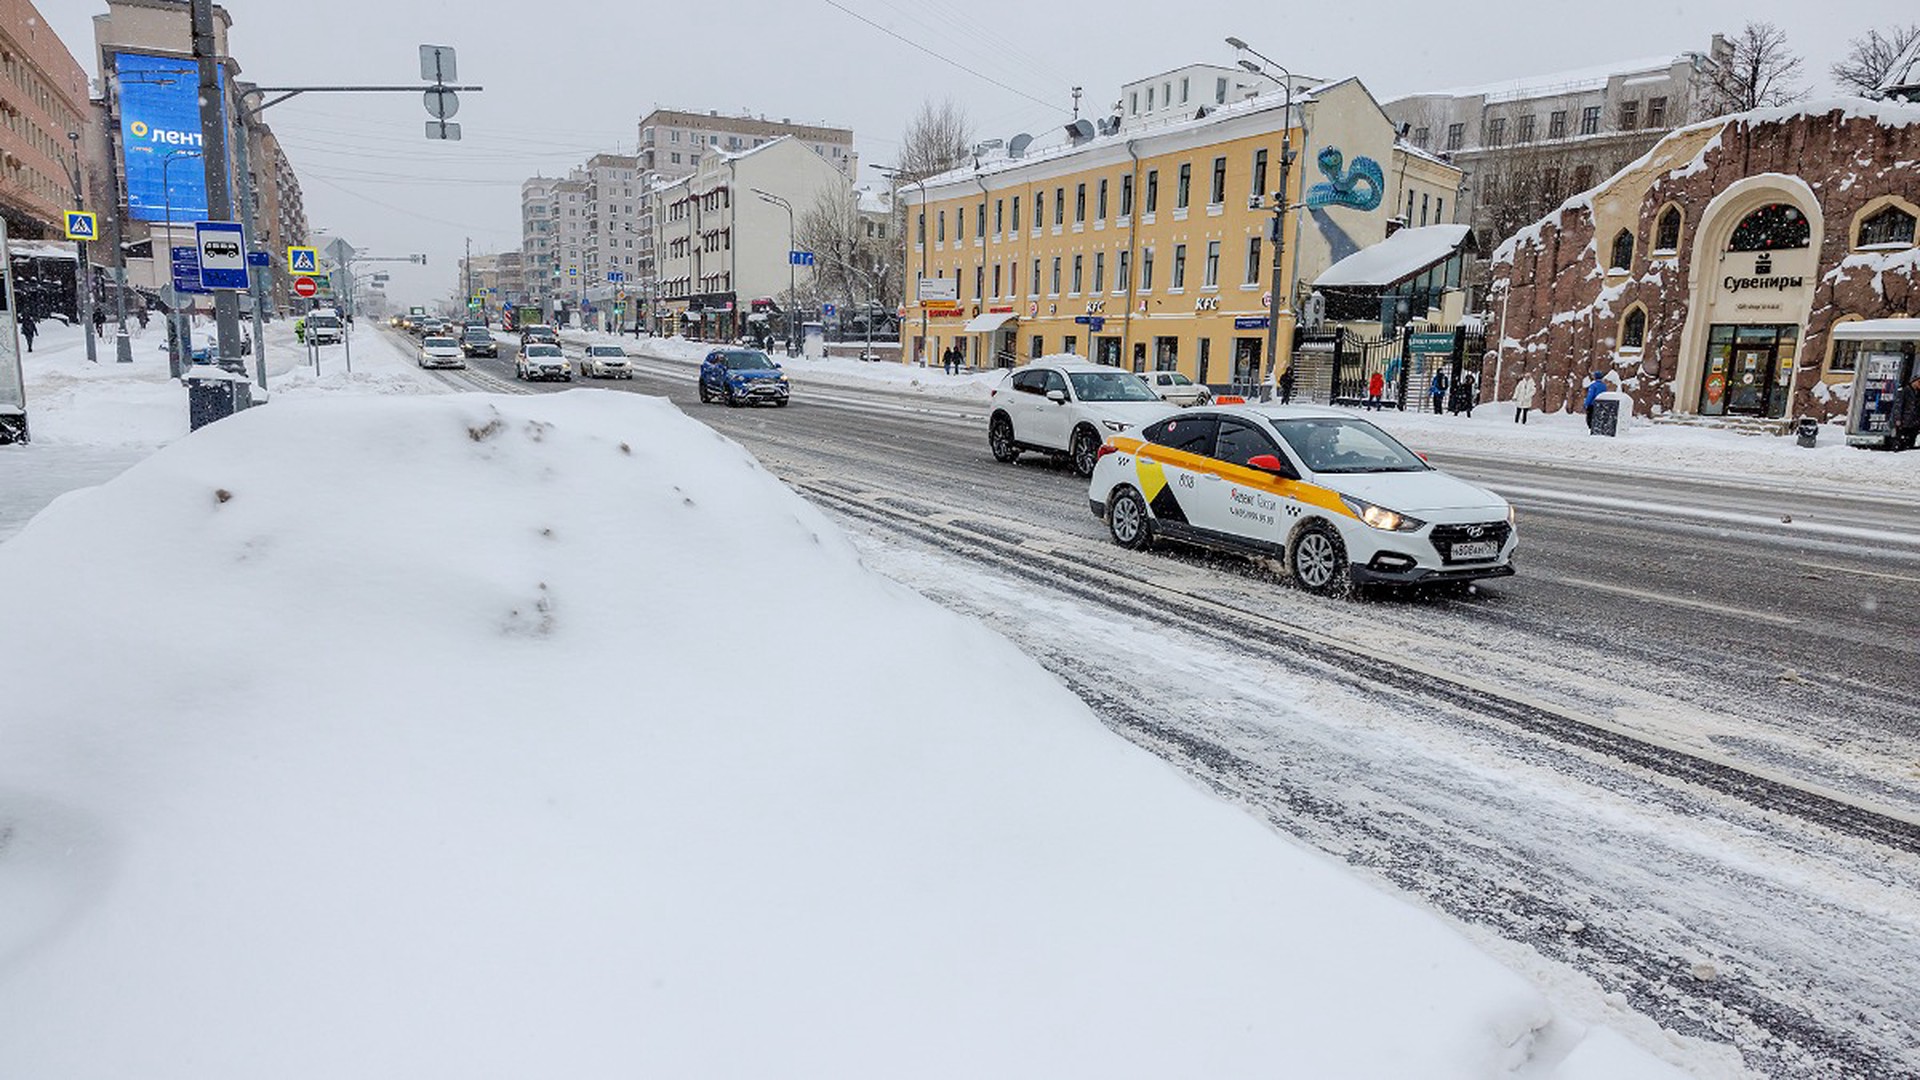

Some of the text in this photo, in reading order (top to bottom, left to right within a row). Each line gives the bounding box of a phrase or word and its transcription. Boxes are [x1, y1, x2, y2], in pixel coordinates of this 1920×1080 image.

[1723, 276, 1803, 293] Сувениры
[1086, 300, 1105, 313] KFC
[1195, 297, 1219, 311] KFC
